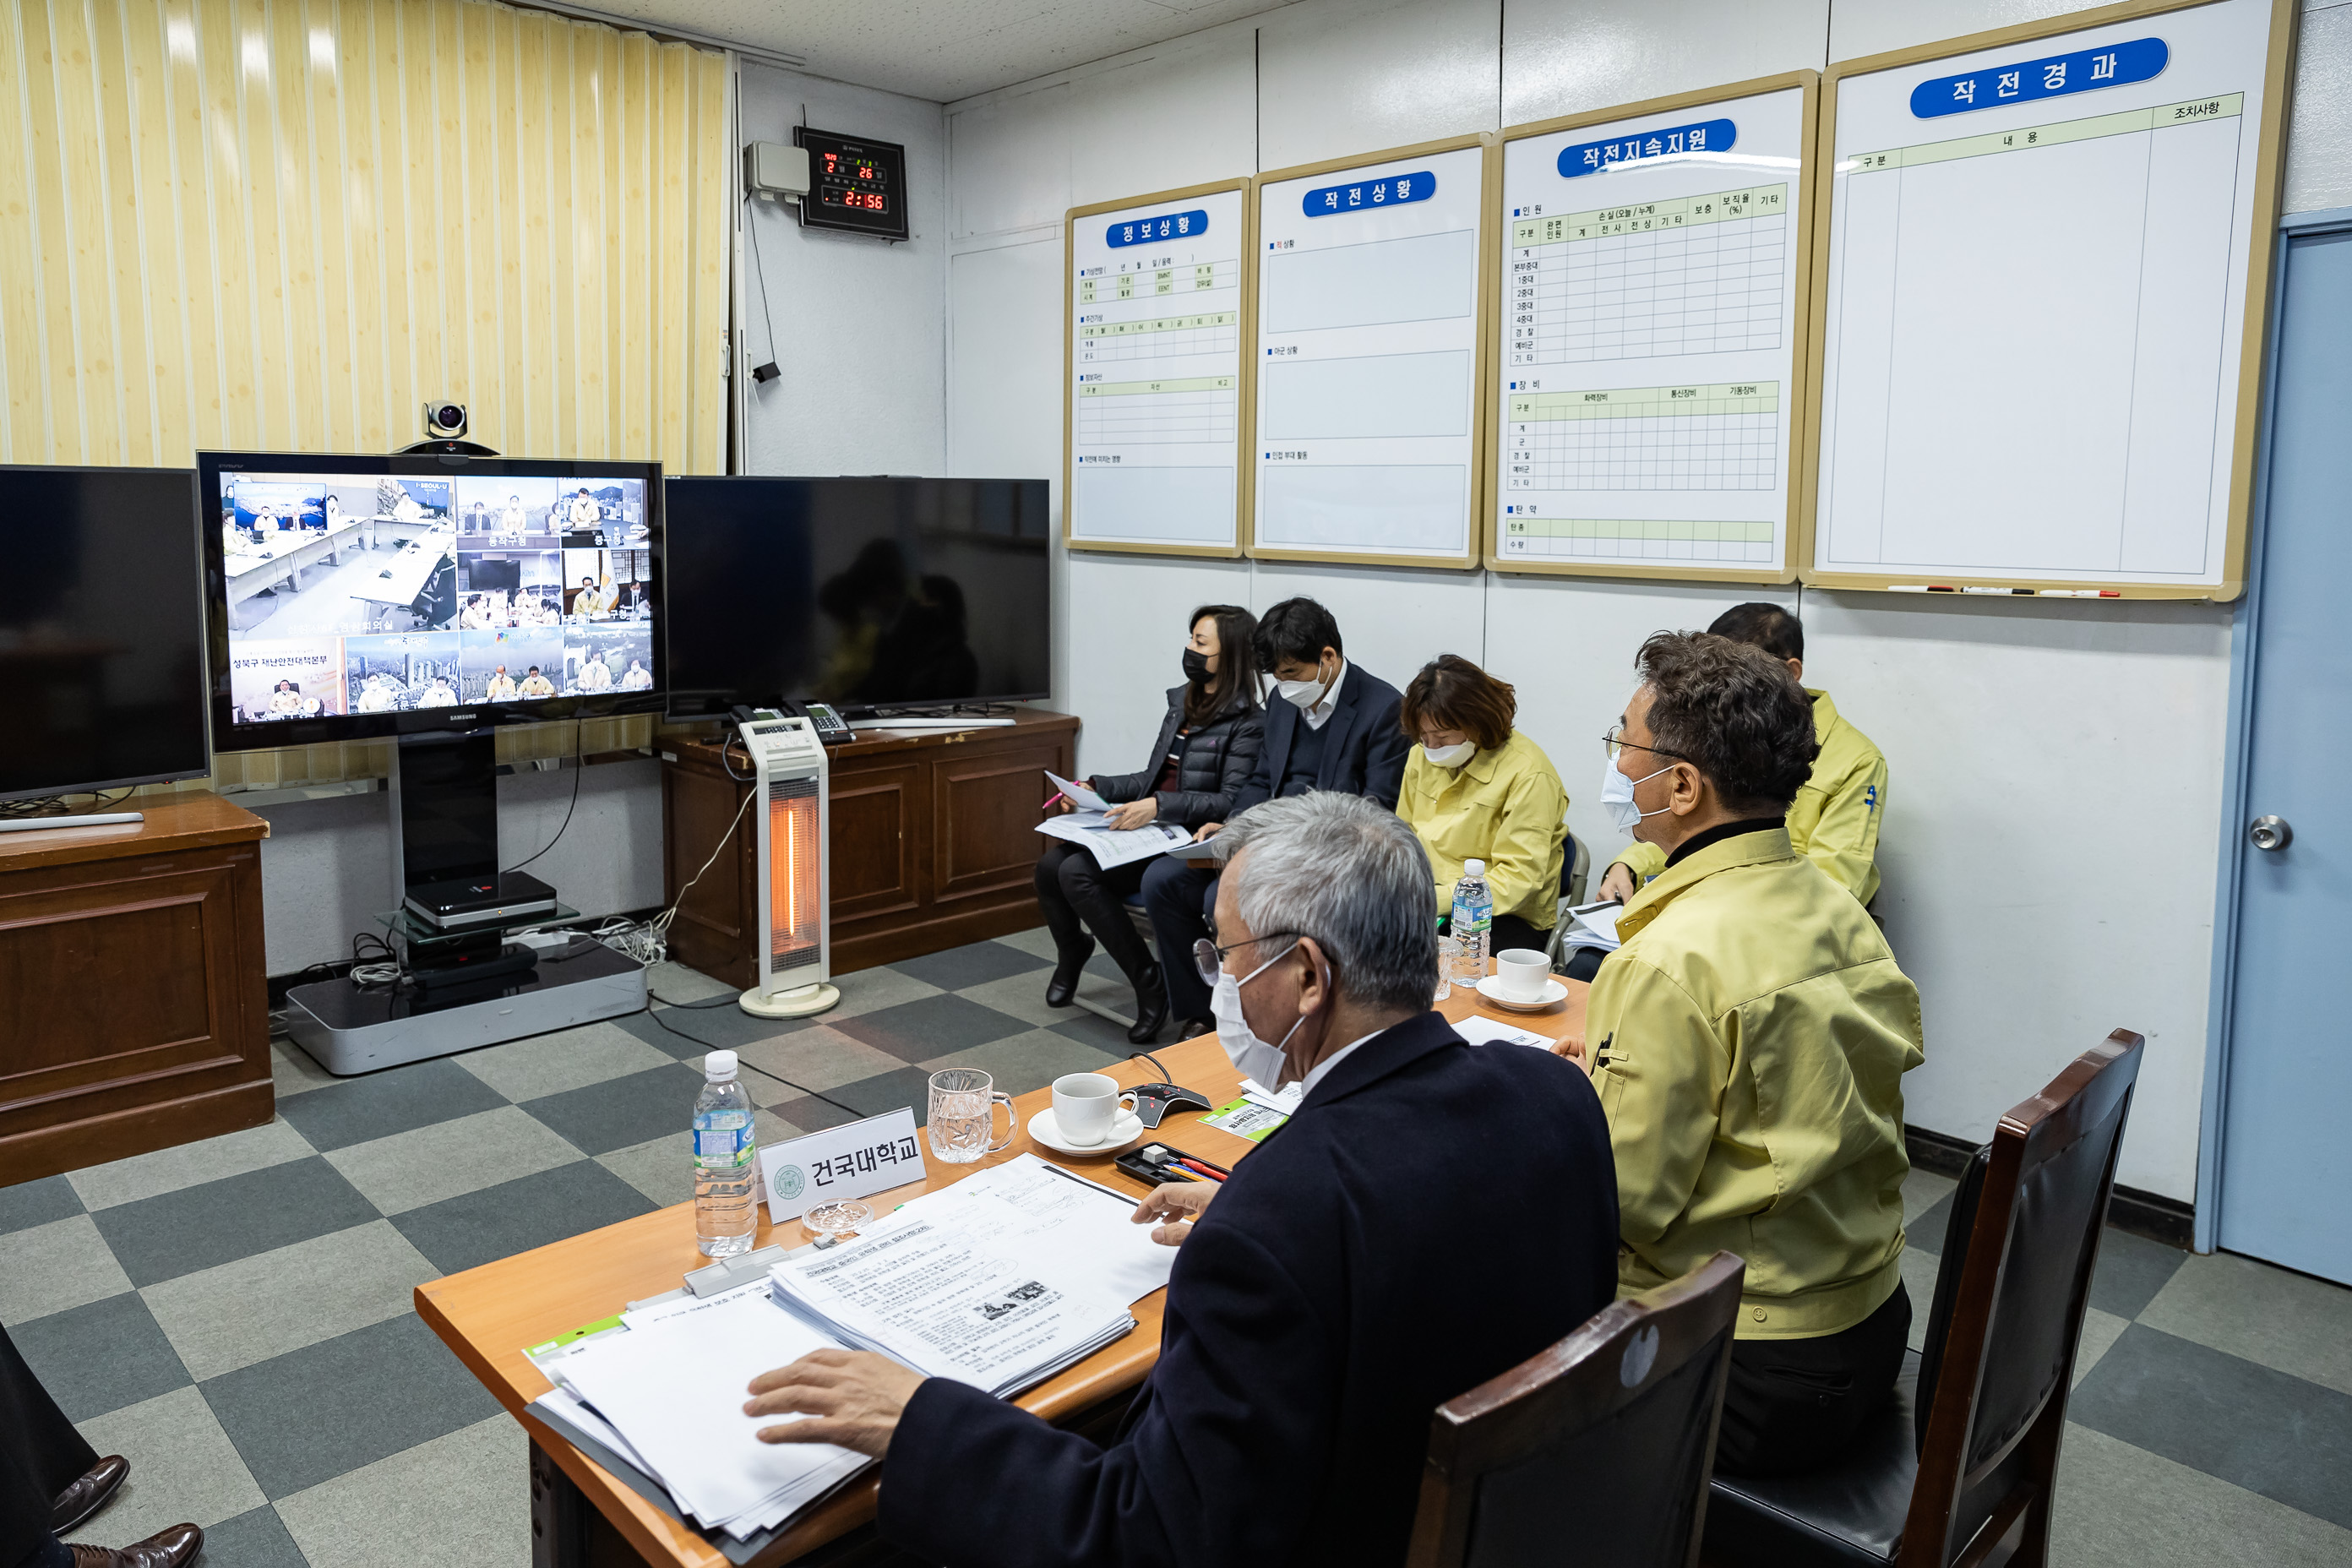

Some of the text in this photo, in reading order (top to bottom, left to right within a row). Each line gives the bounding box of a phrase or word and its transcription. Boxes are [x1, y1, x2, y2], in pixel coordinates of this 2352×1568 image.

[2174, 101, 2220, 120] 조치사항
[1583, 128, 1707, 167] 작전지속지원
[827, 161, 835, 173] 2
[859, 166, 873, 179] 26
[1761, 194, 1778, 205] 기타
[1695, 204, 1712, 215] 보충
[1729, 205, 1742, 215] (%)
[1520, 229, 1534, 238] 구분
[1283, 239, 1294, 248] 상황
[1514, 261, 1538, 271] 본부중대
[1518, 275, 1533, 285] 1중대
[1517, 288, 1533, 297] 2중대
[1516, 302, 1533, 311] 3중대
[1516, 315, 1533, 324] 4중대
[1515, 341, 1533, 350] 예비군
[1274, 346, 1298, 356] 아군 상황
[1671, 389, 1696, 398] 통신장비
[1729, 385, 1757, 395] 기동장비
[1584, 393, 1609, 401] 화력장비
[1519, 438, 1525, 446] 군
[487, 535, 527, 547] 동작구청
[594, 534, 621, 546] 중구청
[233, 655, 328, 668] 성북구 재난안전대책본부
[811, 1135, 918, 1187] 건국대학교
